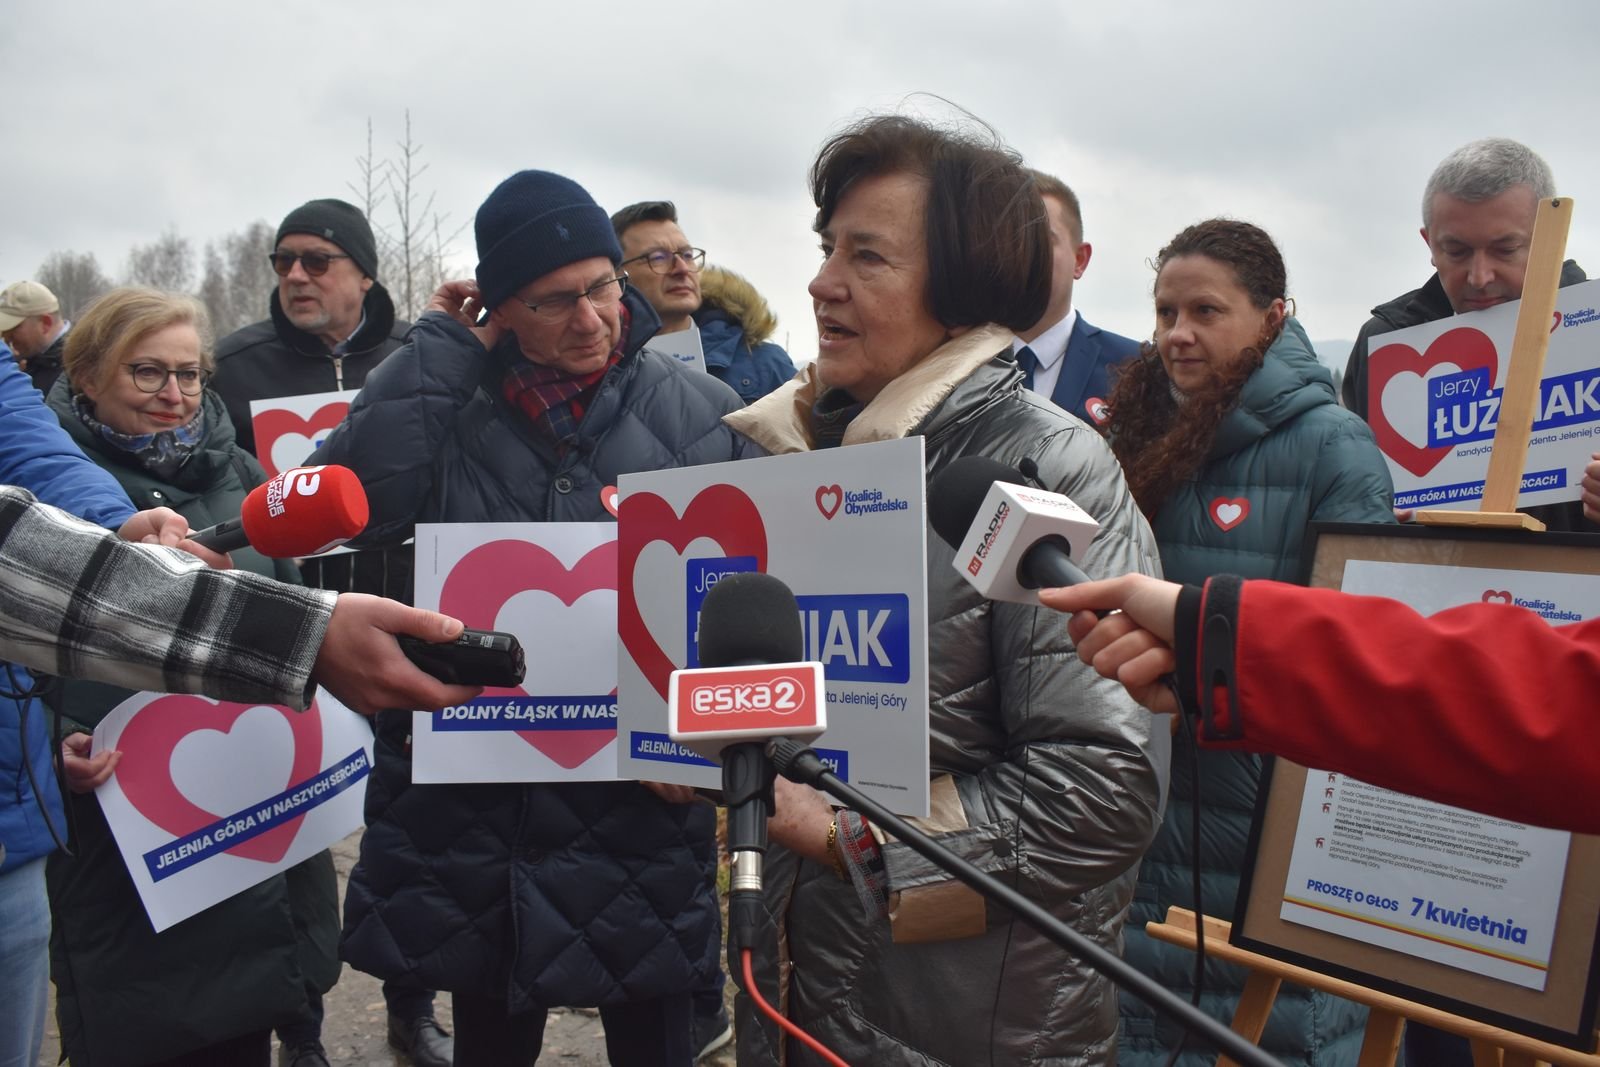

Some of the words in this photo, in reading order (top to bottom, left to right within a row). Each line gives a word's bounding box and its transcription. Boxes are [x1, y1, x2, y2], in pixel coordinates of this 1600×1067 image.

[1563, 308, 1595, 321] Koalicja
[1563, 312, 1600, 327] Obywate
[1435, 376, 1480, 398] Jerzy
[1457, 445, 1493, 457] kandyda
[1559, 427, 1593, 441] Jeleniej
[844, 488, 882, 503] Koalicja
[1394, 494, 1418, 506] LENIA
[1419, 490, 1446, 503] GÓRA
[1448, 488, 1460, 499] W
[1459, 484, 1485, 497] NASZ
[1521, 474, 1558, 489] RCACH
[844, 498, 908, 516] Obywatelska
[976, 501, 1007, 559] RADIO
[1514, 598, 1556, 611] Koalicja
[442, 705, 501, 720] DOLNY
[504, 701, 558, 723] ŚLĄSK
[562, 705, 582, 719] W
[583, 704, 618, 719] NAS
[839, 691, 879, 710] Jeleniej
[881, 693, 908, 712] Góry
[638, 739, 678, 757] JELENIA
[157, 834, 213, 869] JELENIA
[214, 815, 256, 843] GÓRA
[257, 806, 272, 824] W
[273, 779, 331, 815] NASZYCH
[329, 755, 366, 787] SERCACH
[1306, 879, 1352, 902] PROSZĘ
[1354, 891, 1365, 902] O
[1366, 894, 1400, 912] GŁOS
[1410, 897, 1425, 917] 7
[1425, 901, 1528, 945] kwietnia
